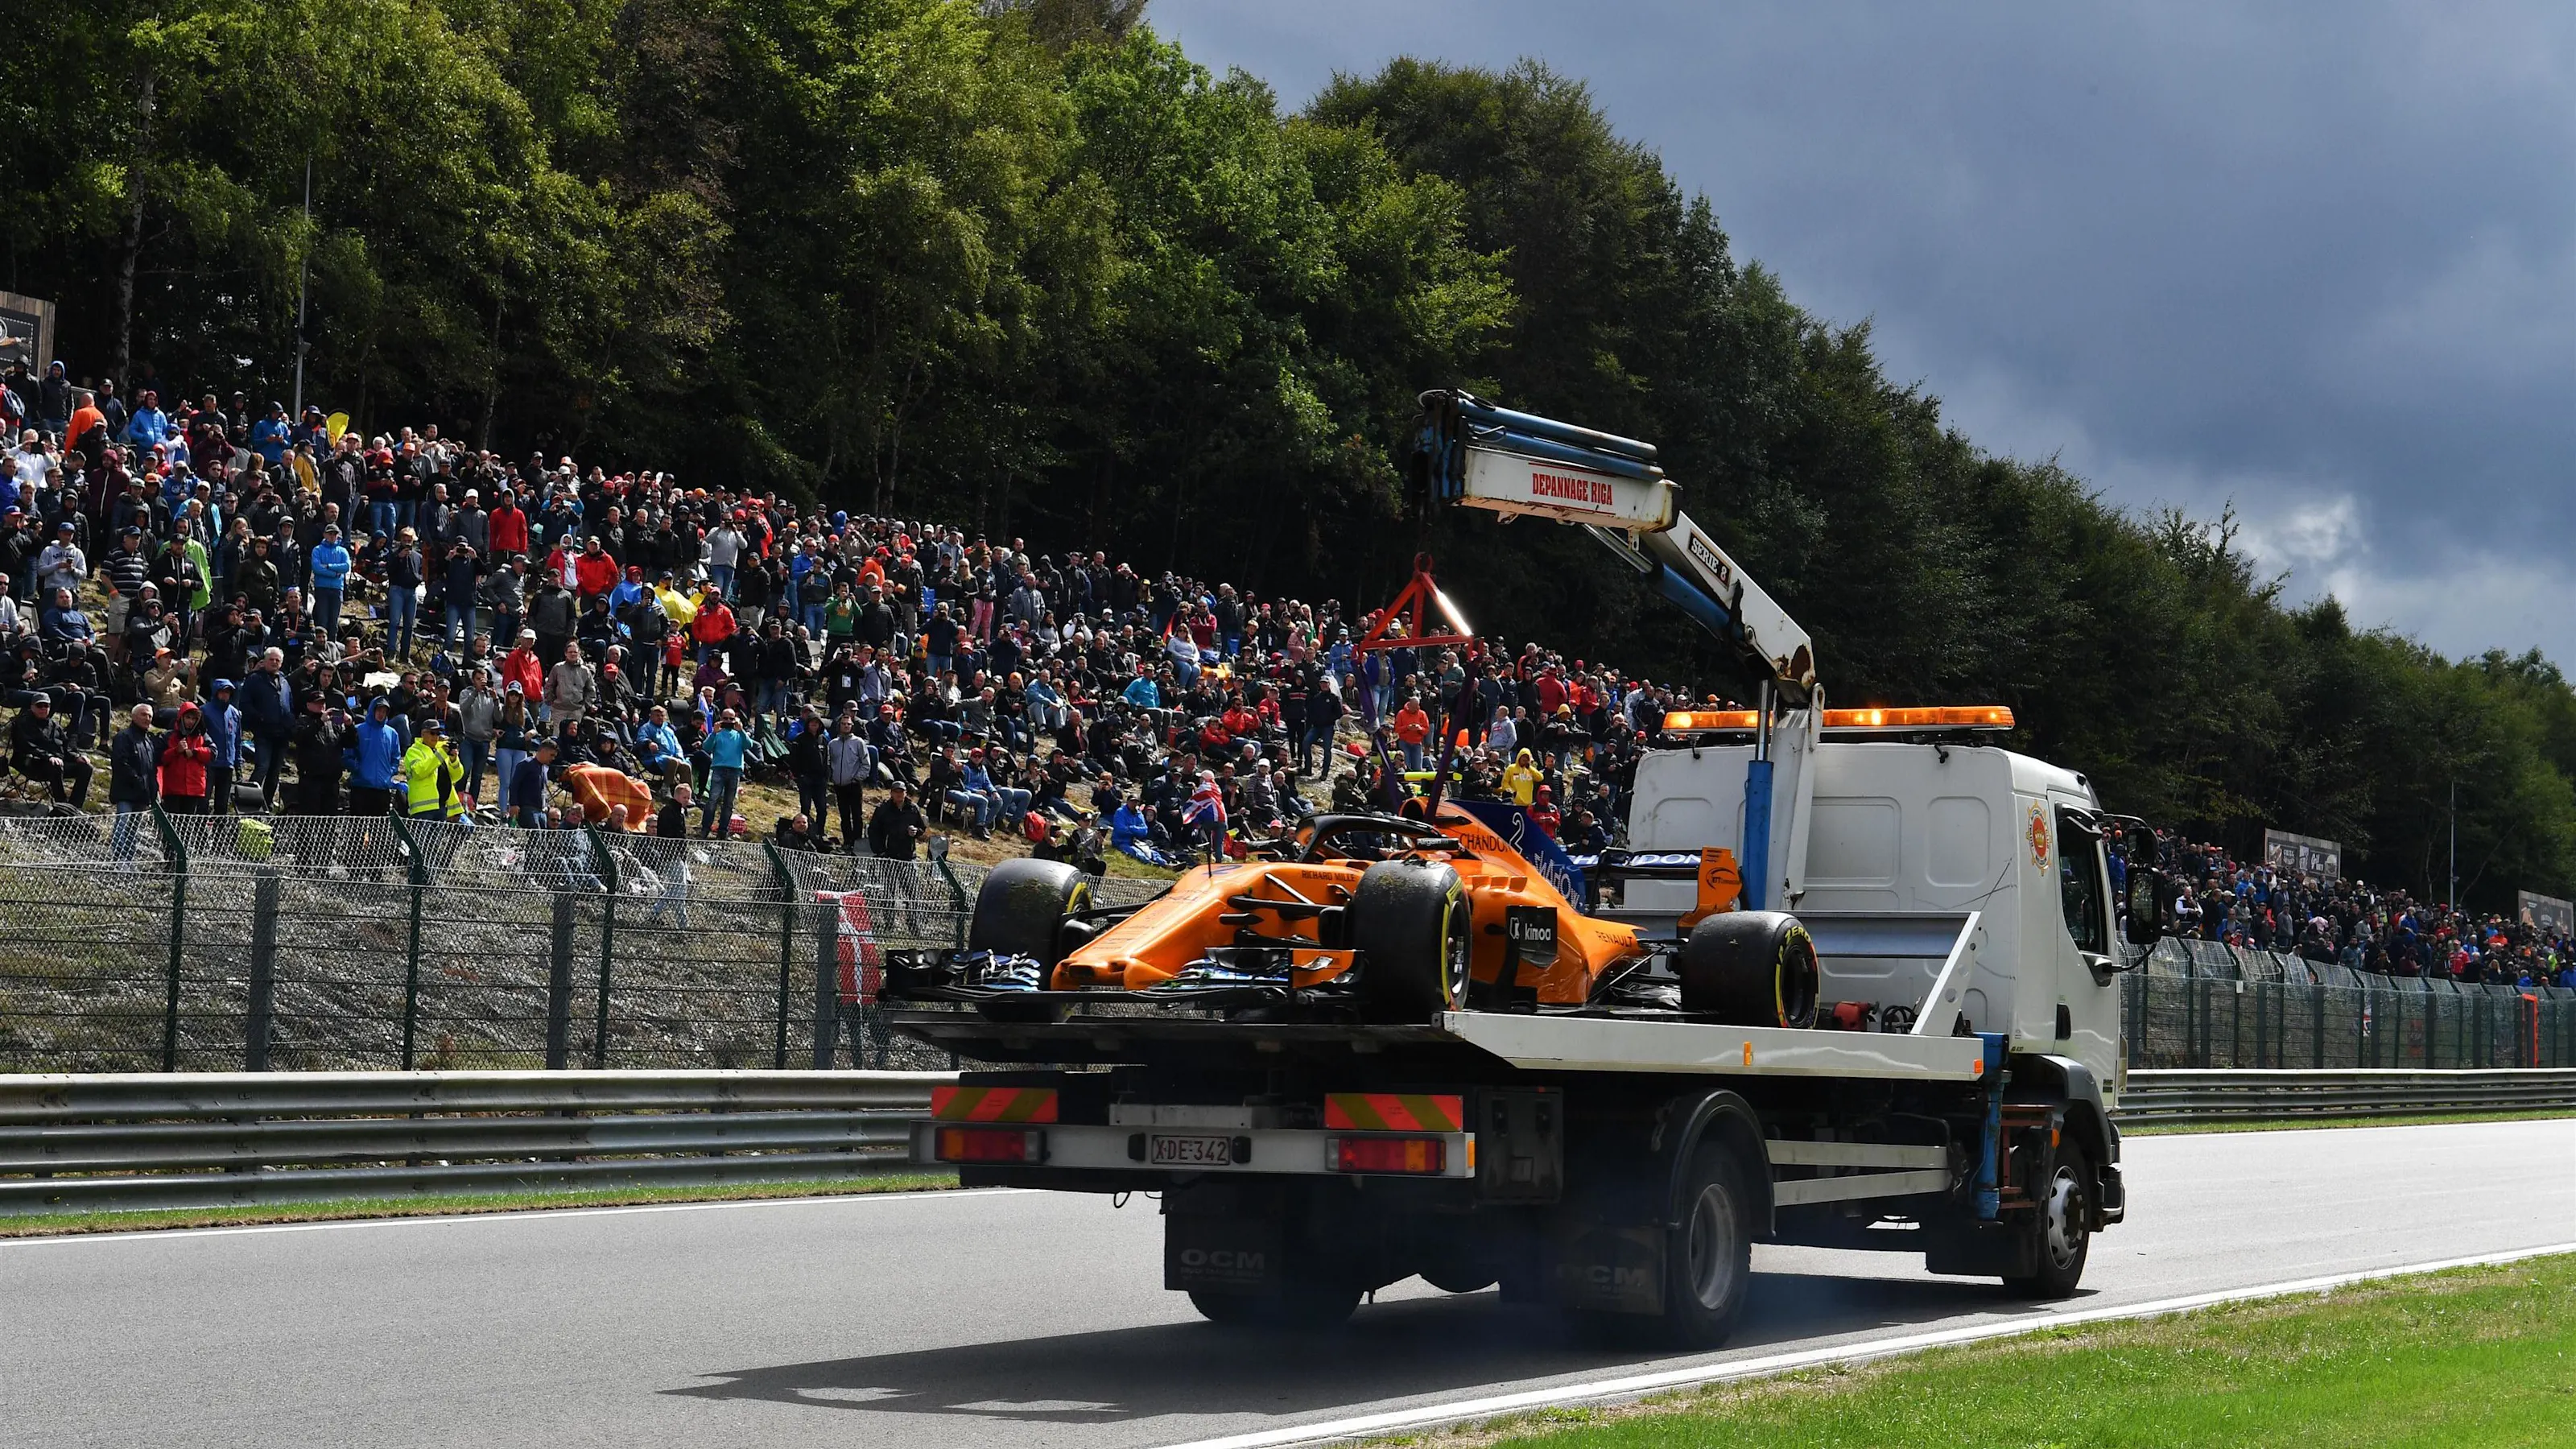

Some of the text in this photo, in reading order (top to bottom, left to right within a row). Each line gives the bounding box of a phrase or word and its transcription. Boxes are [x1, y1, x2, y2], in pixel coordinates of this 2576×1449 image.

[1532, 473, 1612, 506] DEPANNAGE RIGA
[1691, 537, 1728, 581] SERIE 8
[1509, 811, 1525, 854] 2
[1302, 870, 1356, 882] RICHARD MILLE
[1524, 923, 1551, 941] kimoa
[1596, 931, 1633, 947] RENAULT
[1785, 925, 1811, 945] ZERO
[1180, 1248, 1265, 1270] OCM
